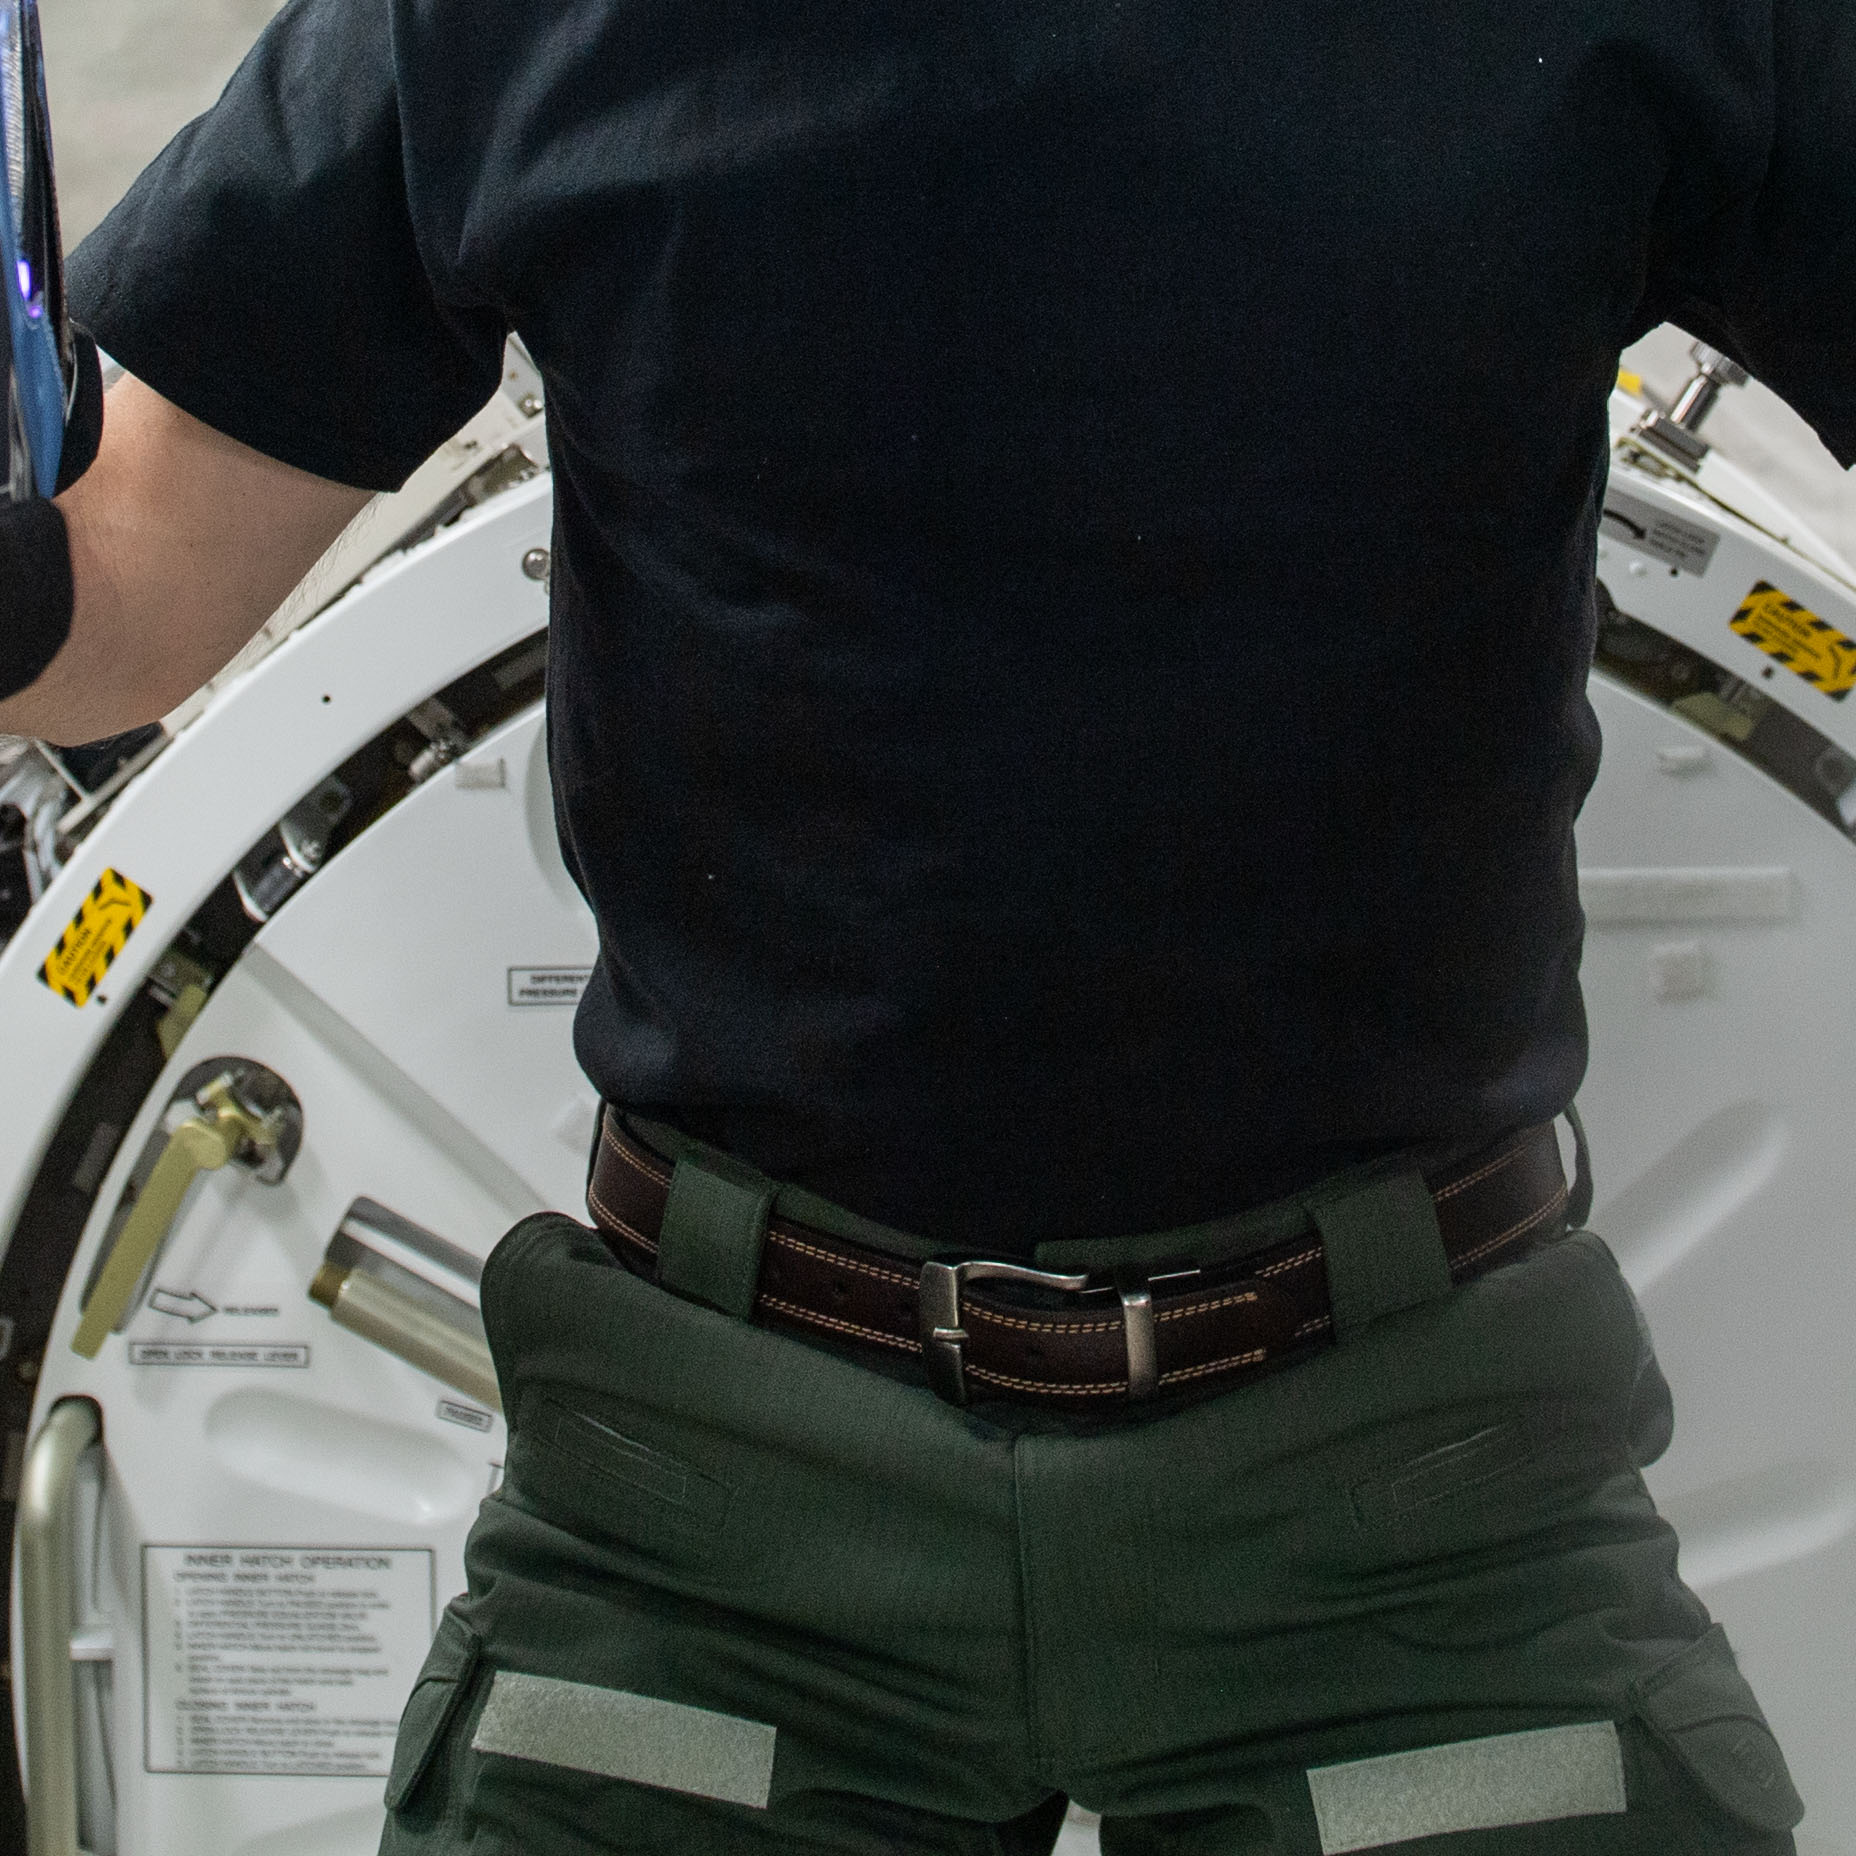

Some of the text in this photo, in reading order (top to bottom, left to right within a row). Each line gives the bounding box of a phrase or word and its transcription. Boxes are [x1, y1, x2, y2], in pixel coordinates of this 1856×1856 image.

[184, 1553, 392, 1570] INNER HATCH OPERATION
